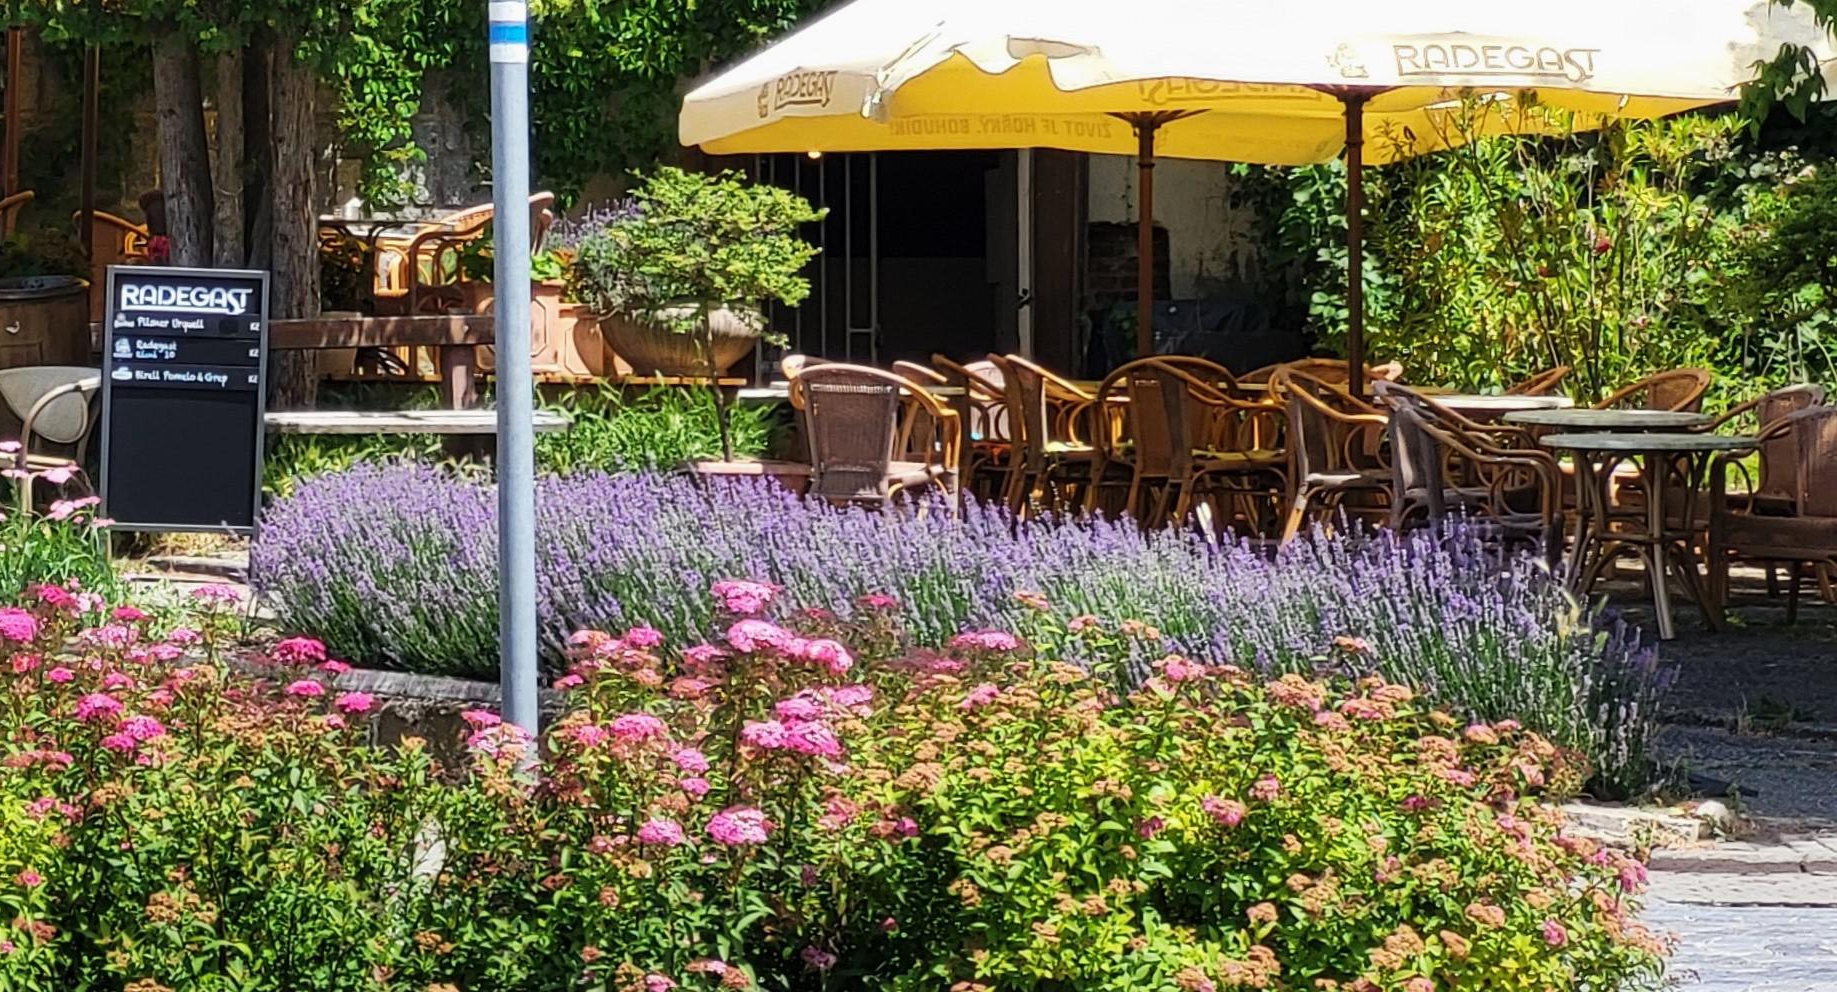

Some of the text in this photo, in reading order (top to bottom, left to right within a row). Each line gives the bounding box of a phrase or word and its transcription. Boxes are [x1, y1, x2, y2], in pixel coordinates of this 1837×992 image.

[1392, 44, 1601, 82] RADEGAST
[774, 70, 838, 110] RADEGAST
[121, 284, 253, 315] RADEGAST
[137, 316, 170, 328] Pilsner
[136, 339, 177, 353] Radegast
[164, 350, 175, 360] 10
